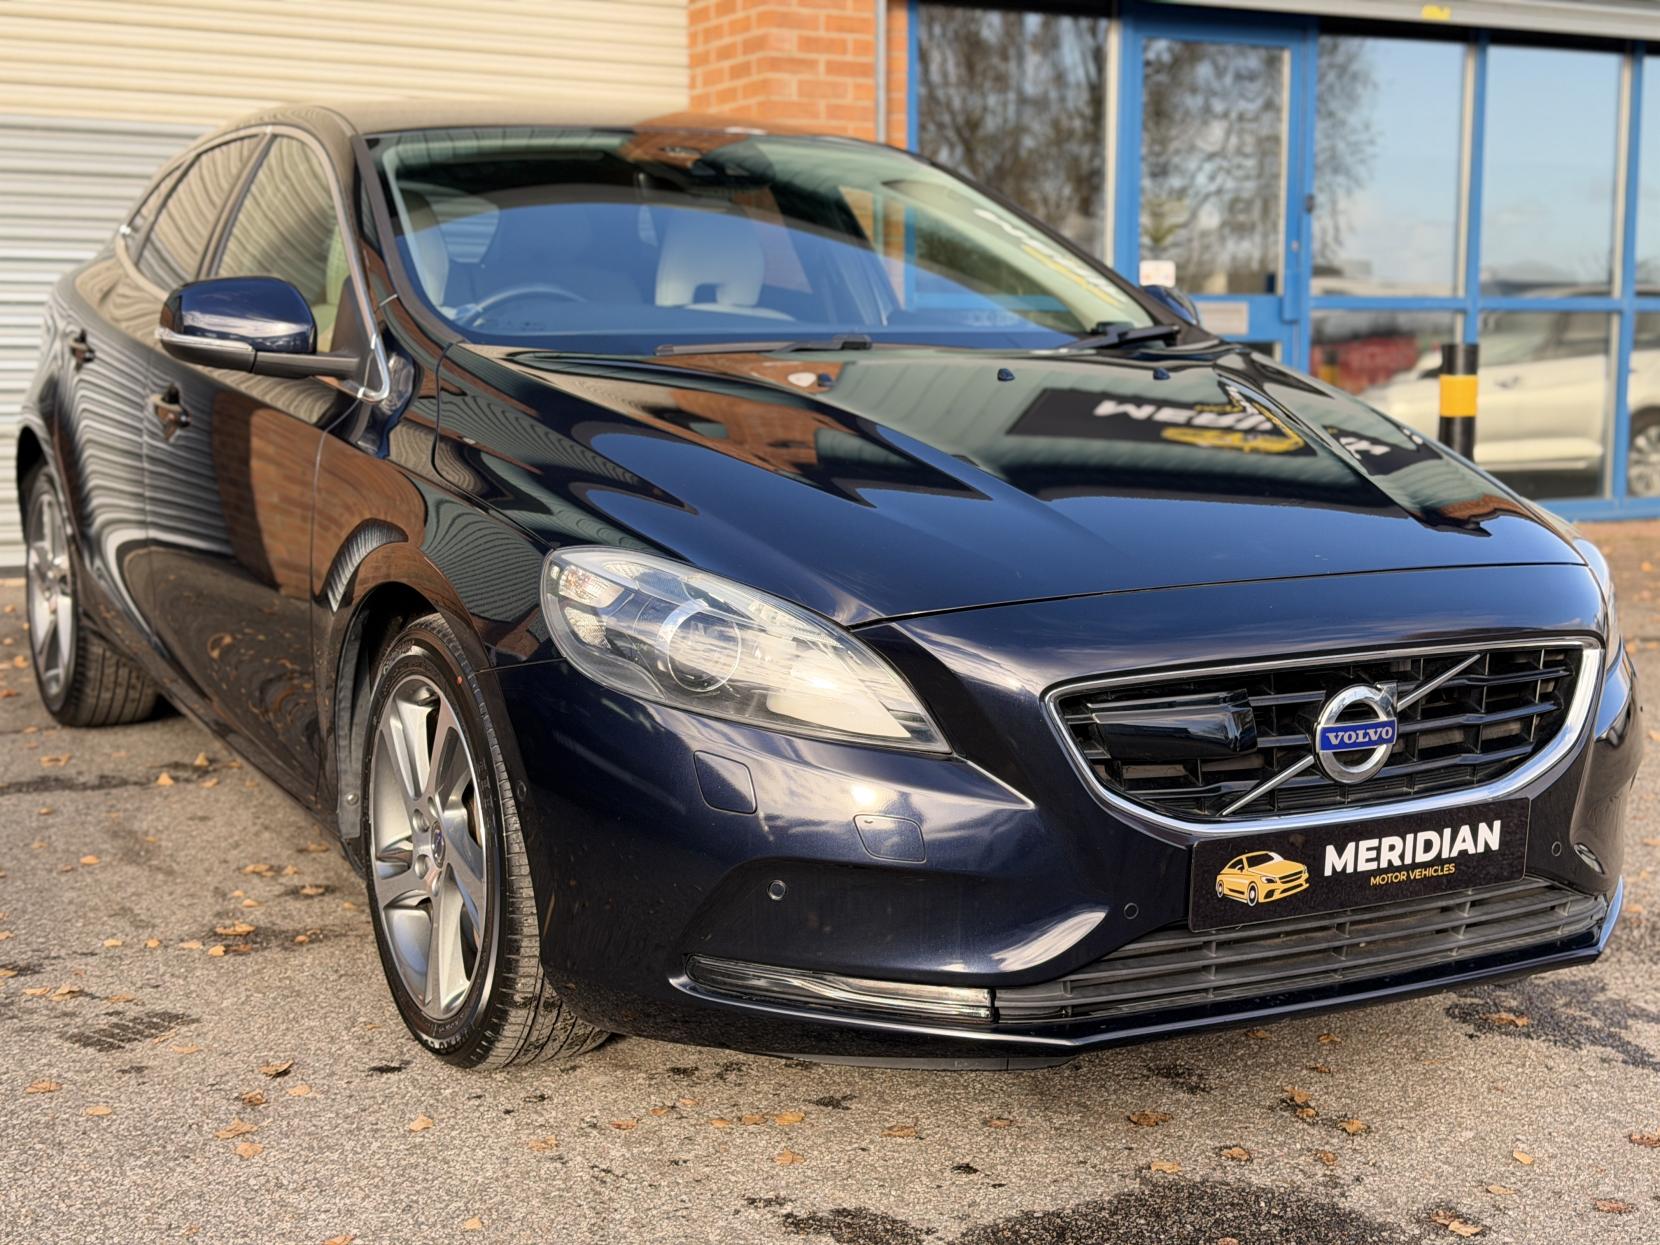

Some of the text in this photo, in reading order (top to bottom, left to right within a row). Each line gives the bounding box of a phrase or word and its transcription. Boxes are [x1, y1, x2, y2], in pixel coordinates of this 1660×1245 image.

[1326, 726, 1393, 745] VOLVO
[1324, 820, 1502, 877] MERIDIAN
[1370, 863, 1456, 886] MOTOR VEHICLES
